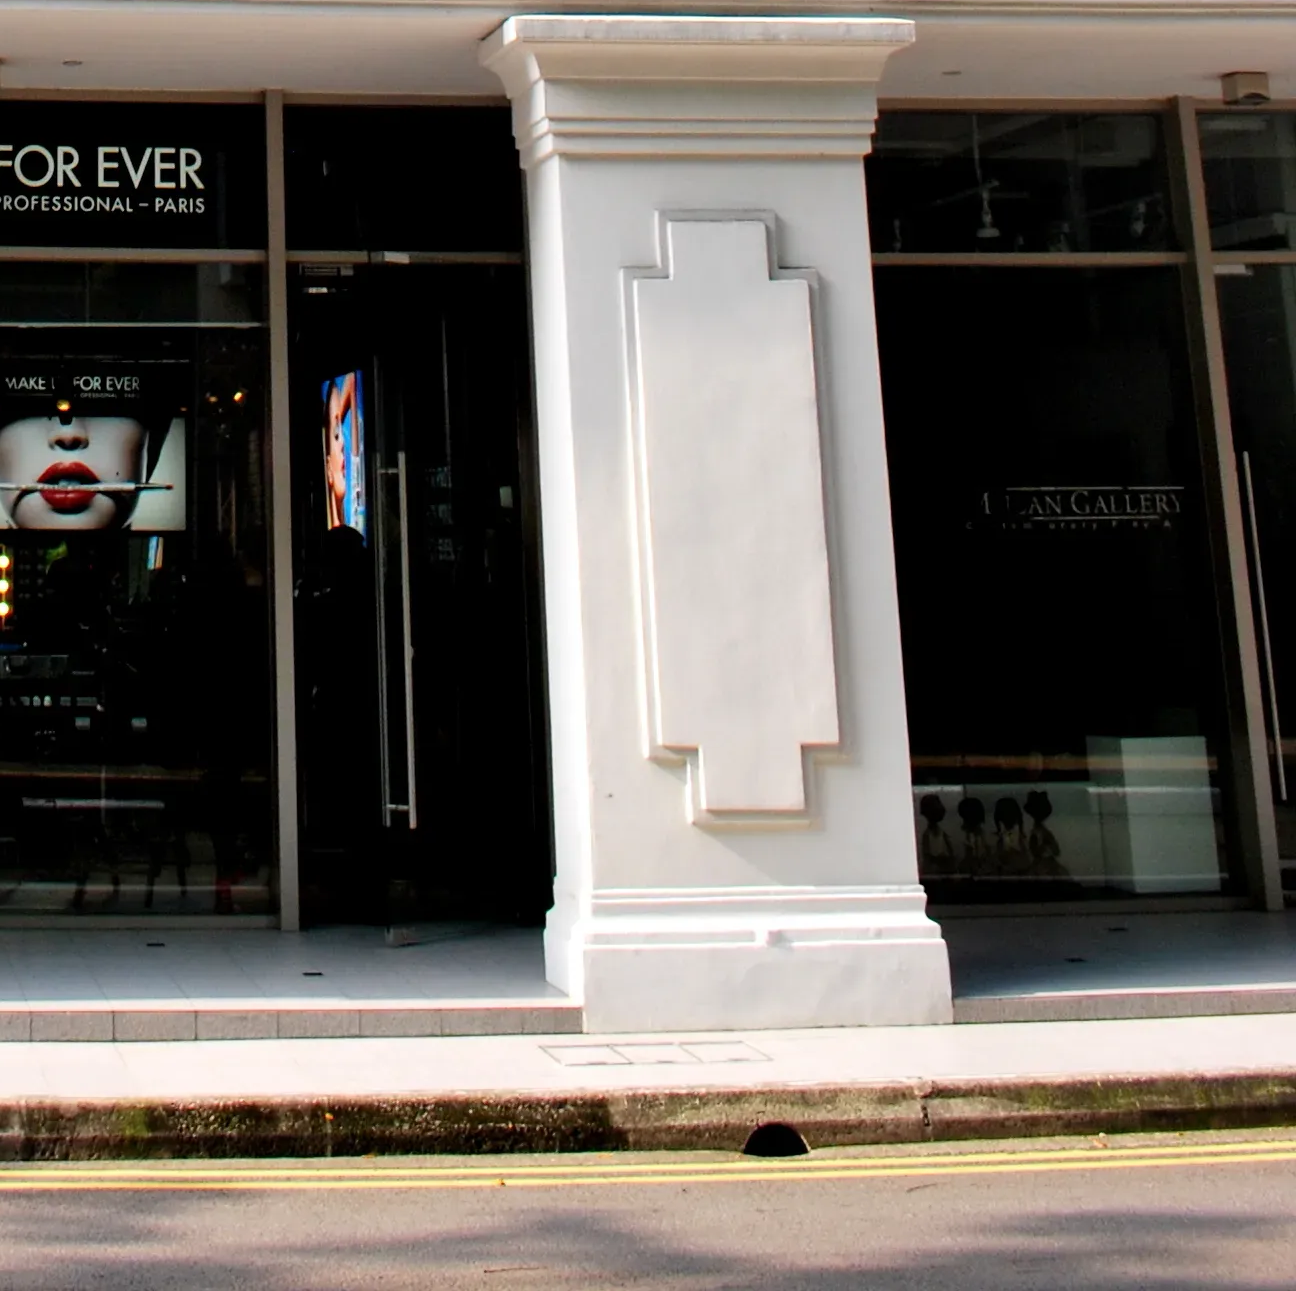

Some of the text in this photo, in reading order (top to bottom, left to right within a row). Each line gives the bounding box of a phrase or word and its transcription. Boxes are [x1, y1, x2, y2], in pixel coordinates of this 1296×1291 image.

[98, 147, 205, 190] EVER
[155, 197, 205, 214] PARIS
[5, 376, 46, 391] MAKE
[73, 376, 102, 392] FOR
[106, 376, 140, 392] EVER
[1070, 490, 1182, 515] GALLERY
